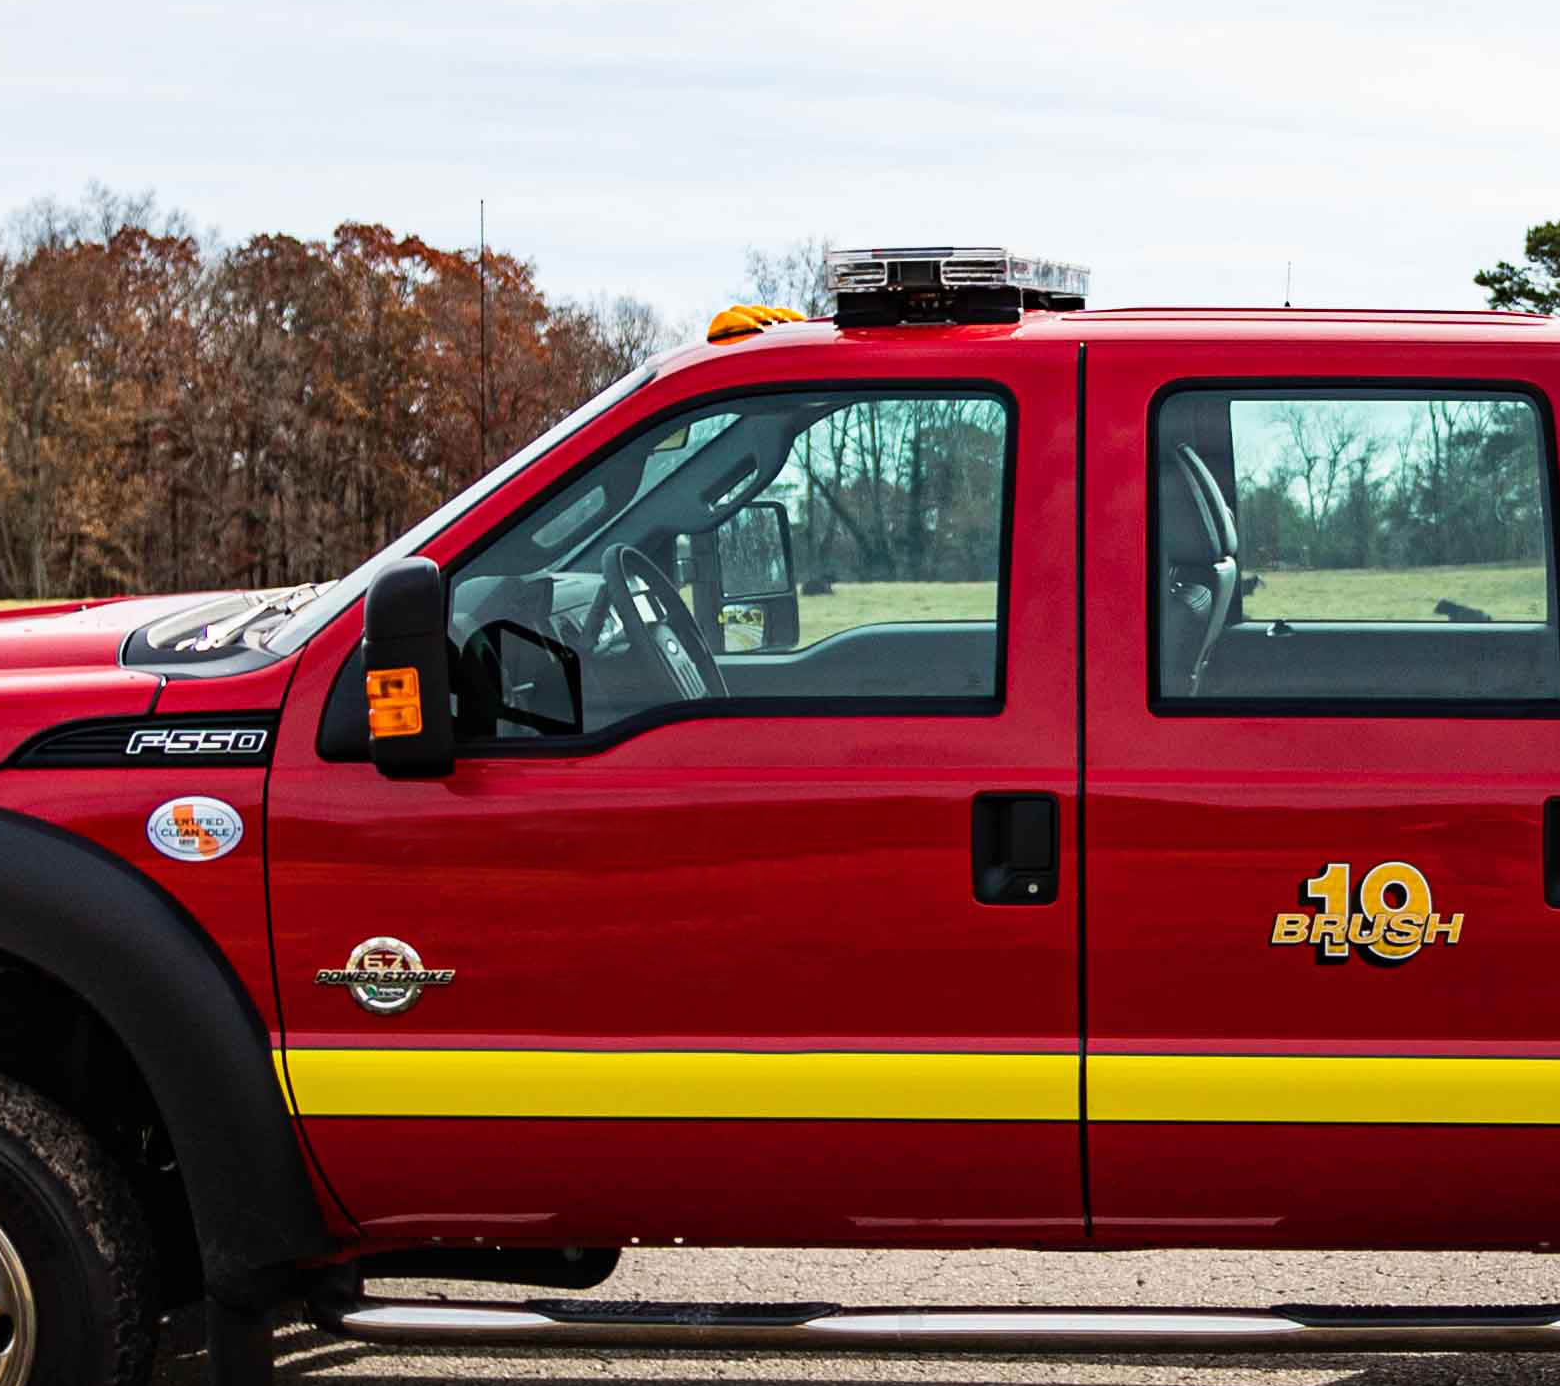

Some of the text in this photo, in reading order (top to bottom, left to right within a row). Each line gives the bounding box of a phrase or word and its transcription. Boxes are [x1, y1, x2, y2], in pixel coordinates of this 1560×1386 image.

[126, 729, 268, 754] F-550
[166, 817, 225, 826] CERTIFIED
[160, 828, 230, 838] CLEAN IDLE
[1307, 861, 1433, 960] 19
[1271, 913, 1465, 945] BRUSH
[316, 970, 454, 983] POWER STROKE
